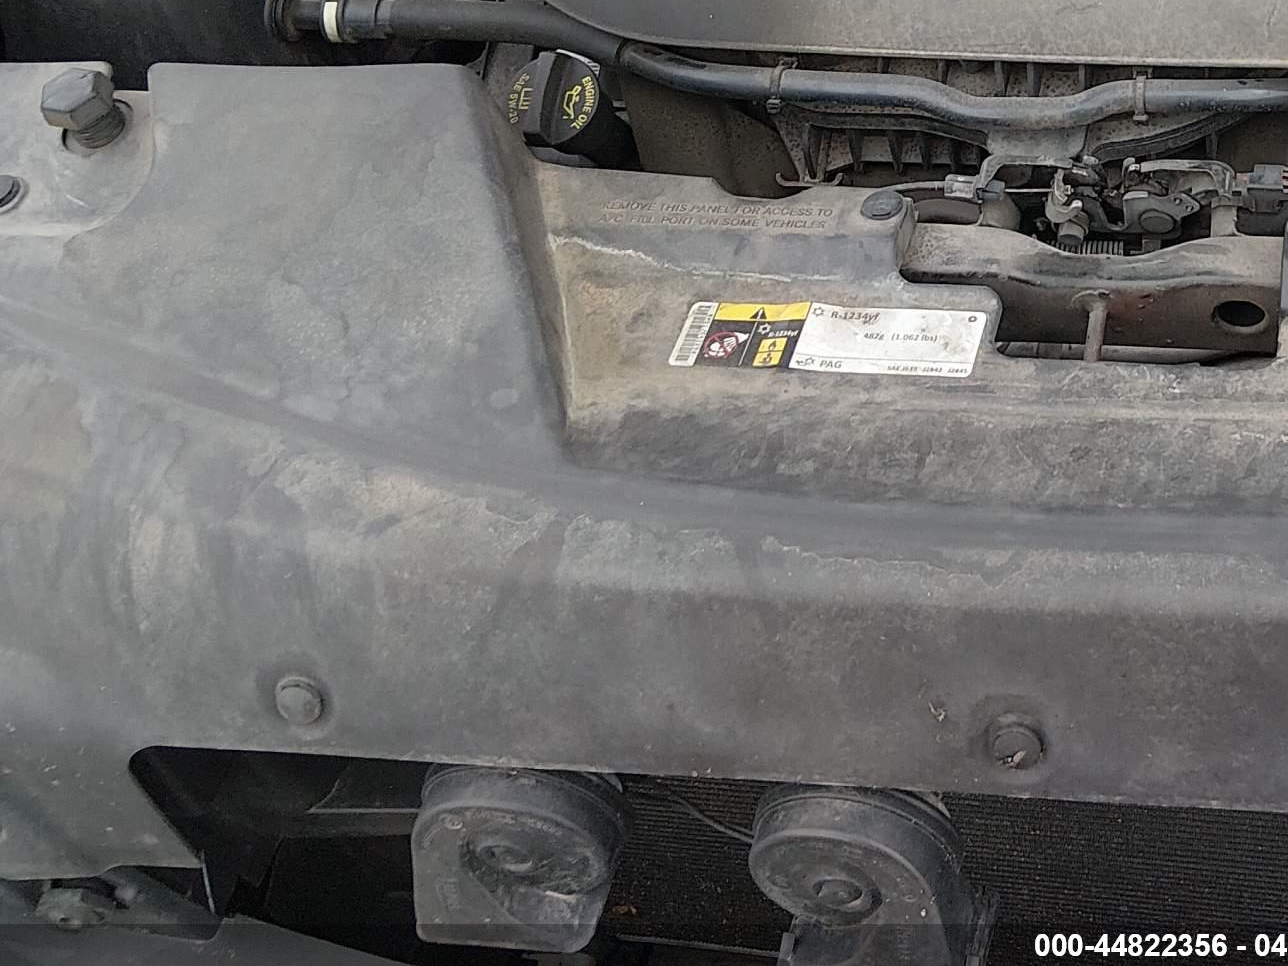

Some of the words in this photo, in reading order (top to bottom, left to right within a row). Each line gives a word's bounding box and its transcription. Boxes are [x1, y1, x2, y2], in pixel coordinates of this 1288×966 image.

[581, 75, 595, 114] ENGINE
[570, 113, 590, 130] OIL
[762, 206, 813, 216] ACCESS
[817, 207, 833, 217] TO
[698, 217, 720, 226] ON
[722, 218, 760, 227] SOME
[819, 359, 843, 370] PAG
